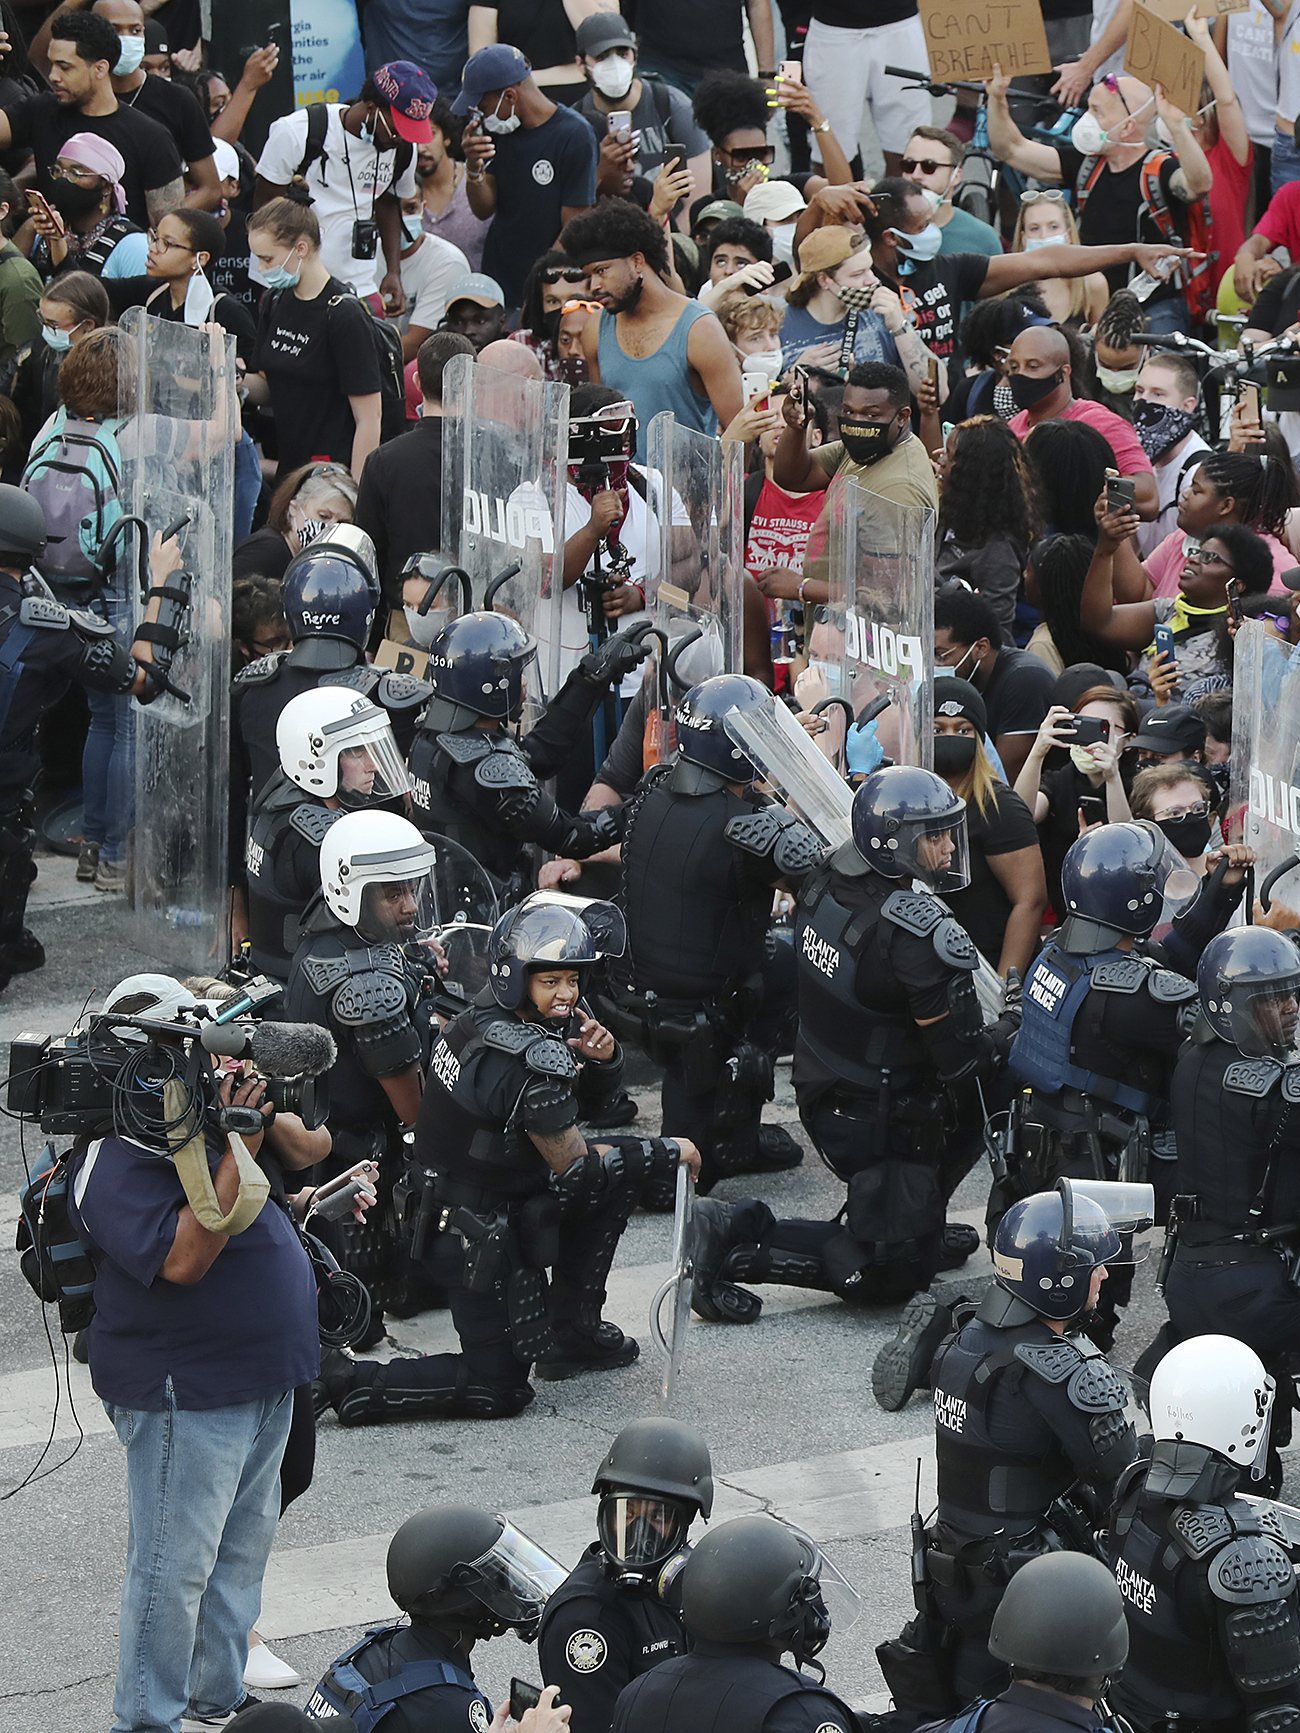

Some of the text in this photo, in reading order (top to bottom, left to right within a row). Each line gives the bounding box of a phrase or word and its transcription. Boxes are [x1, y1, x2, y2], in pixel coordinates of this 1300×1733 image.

[292, 37, 329, 48] nities
[930, 41, 1042, 76] BREATHE
[309, 69, 326, 80] air
[294, 88, 340, 106] use
[215, 255, 250, 268] ense
[923, 282, 948, 306] get
[936, 302, 952, 320] or
[841, 330, 855, 364] GUESS
[769, 517, 808, 532] STRAUSS
[802, 924, 840, 968] ATLANTA
[802, 939, 834, 979] POLICE
[1028, 980, 1057, 1012] POLICE
[1033, 963, 1067, 999] ATLANTA
[431, 1052, 453, 1092] POLICE
[434, 1038, 461, 1082] ATLANTA
[934, 1386, 967, 1420] ATLANTA
[934, 1404, 963, 1434] POLICE
[1115, 1556, 1157, 1603] ATLANTA
[1116, 1577, 1153, 1615] POLICE
[572, 1657, 599, 1670] POLICE
